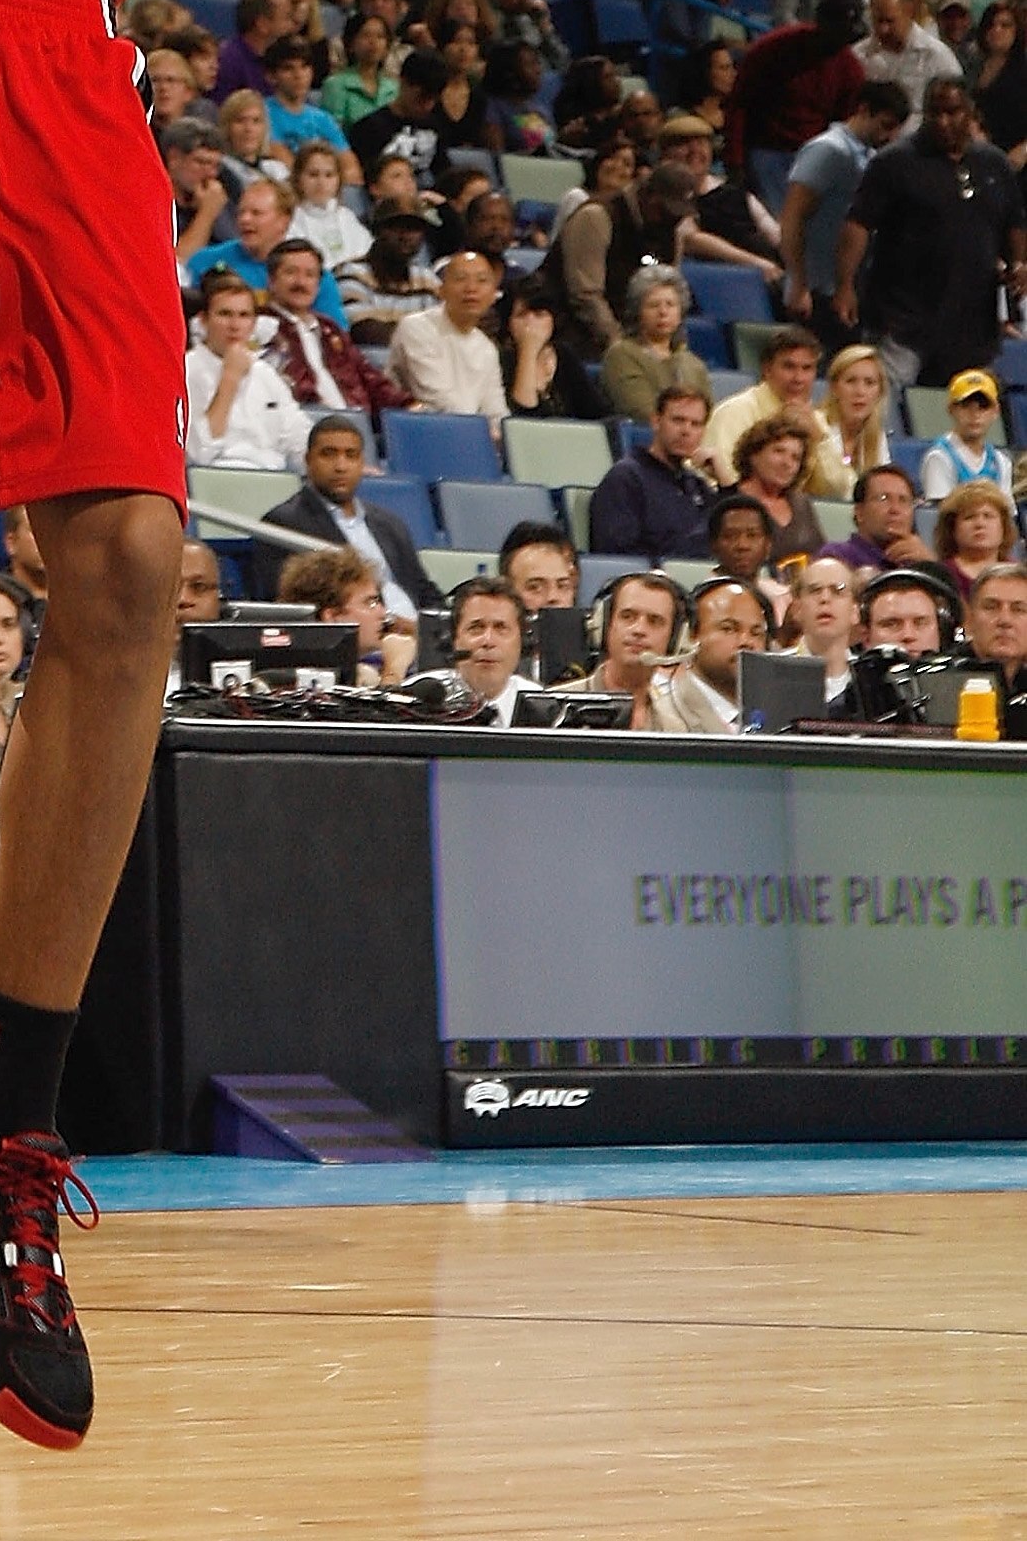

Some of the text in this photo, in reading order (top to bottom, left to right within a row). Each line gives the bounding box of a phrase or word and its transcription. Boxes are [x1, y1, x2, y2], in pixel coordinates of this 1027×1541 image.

[636, 873, 834, 927] EVERYONE
[844, 874, 960, 927] PLAYS
[973, 876, 998, 927] A
[511, 1087, 592, 1108] ANC
